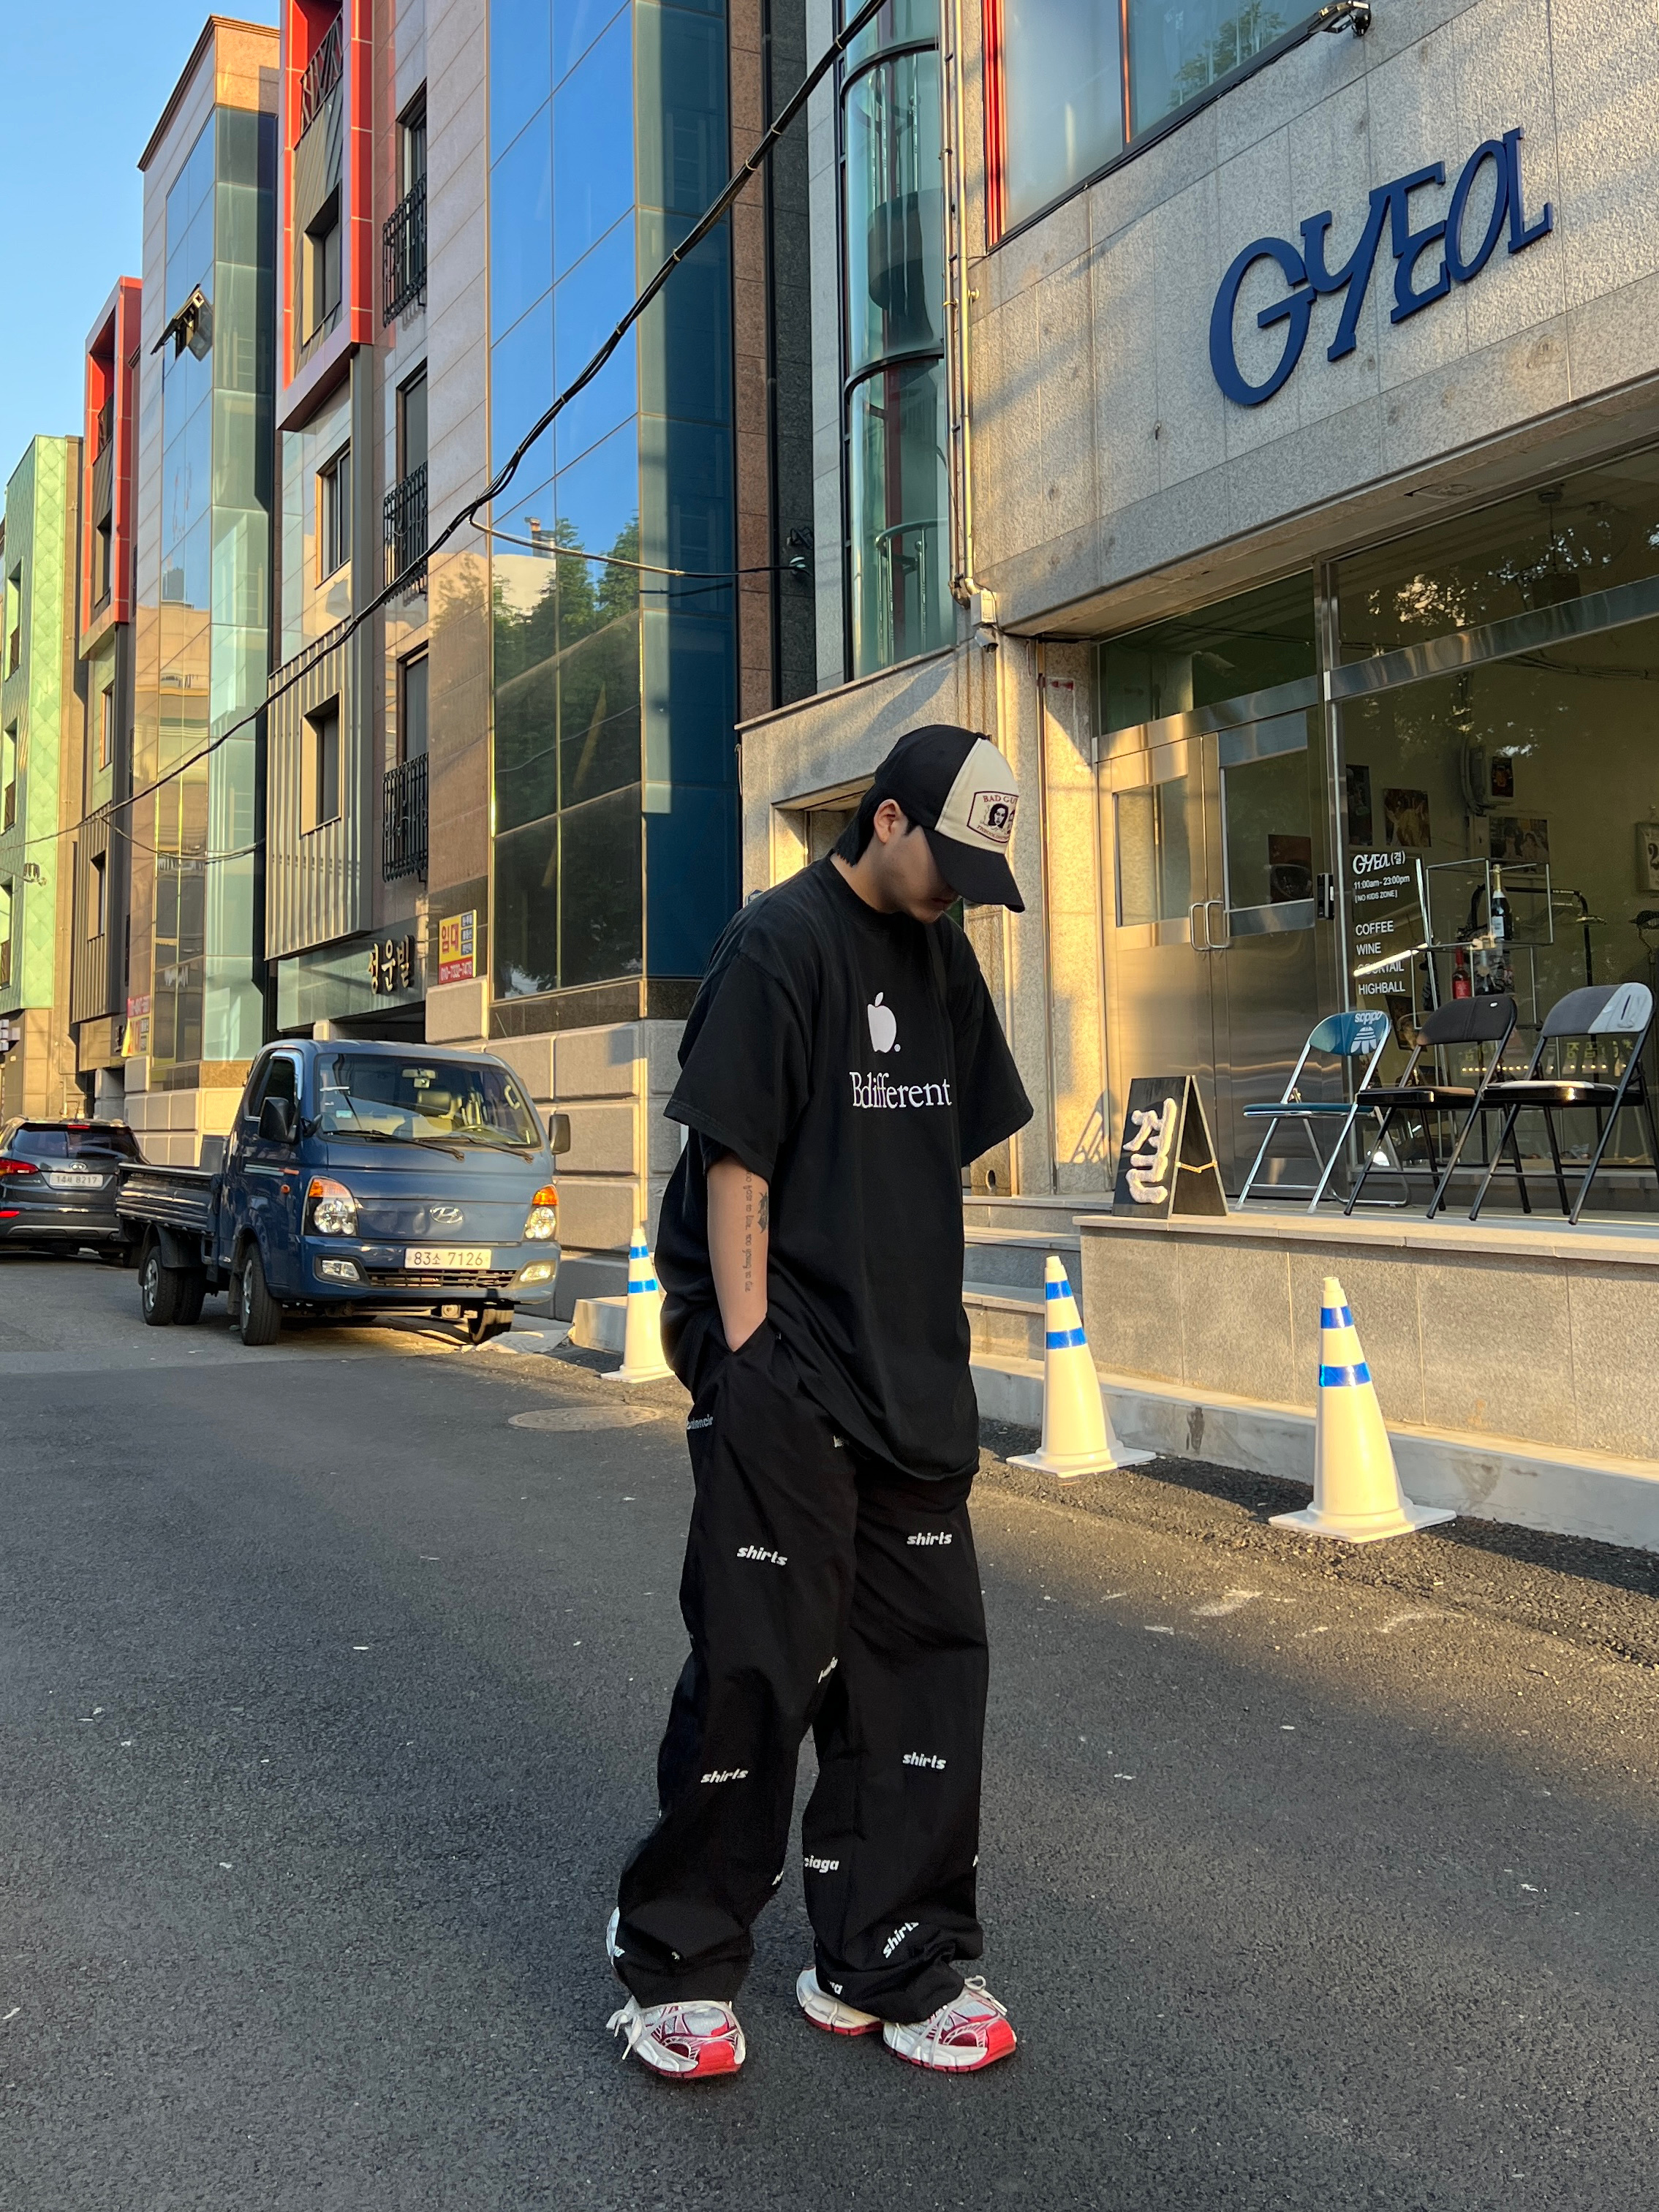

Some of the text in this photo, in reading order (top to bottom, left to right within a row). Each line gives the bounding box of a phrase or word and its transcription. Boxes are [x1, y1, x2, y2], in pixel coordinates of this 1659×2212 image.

[1209, 127, 1554, 406] GYEOL
[983, 794, 1001, 803] BAD
[1356, 921, 1394, 936] COFFEE
[1356, 942, 1382, 956] WINE
[1358, 981, 1406, 995] HIGHBALL
[1122, 1097, 1177, 1204] 결
[447, 1252, 483, 1266] 7126
[906, 1531, 953, 1546] shirts
[736, 1544, 788, 1566] shirts
[902, 1751, 947, 1770] shirts
[700, 1768, 749, 1783] shirts
